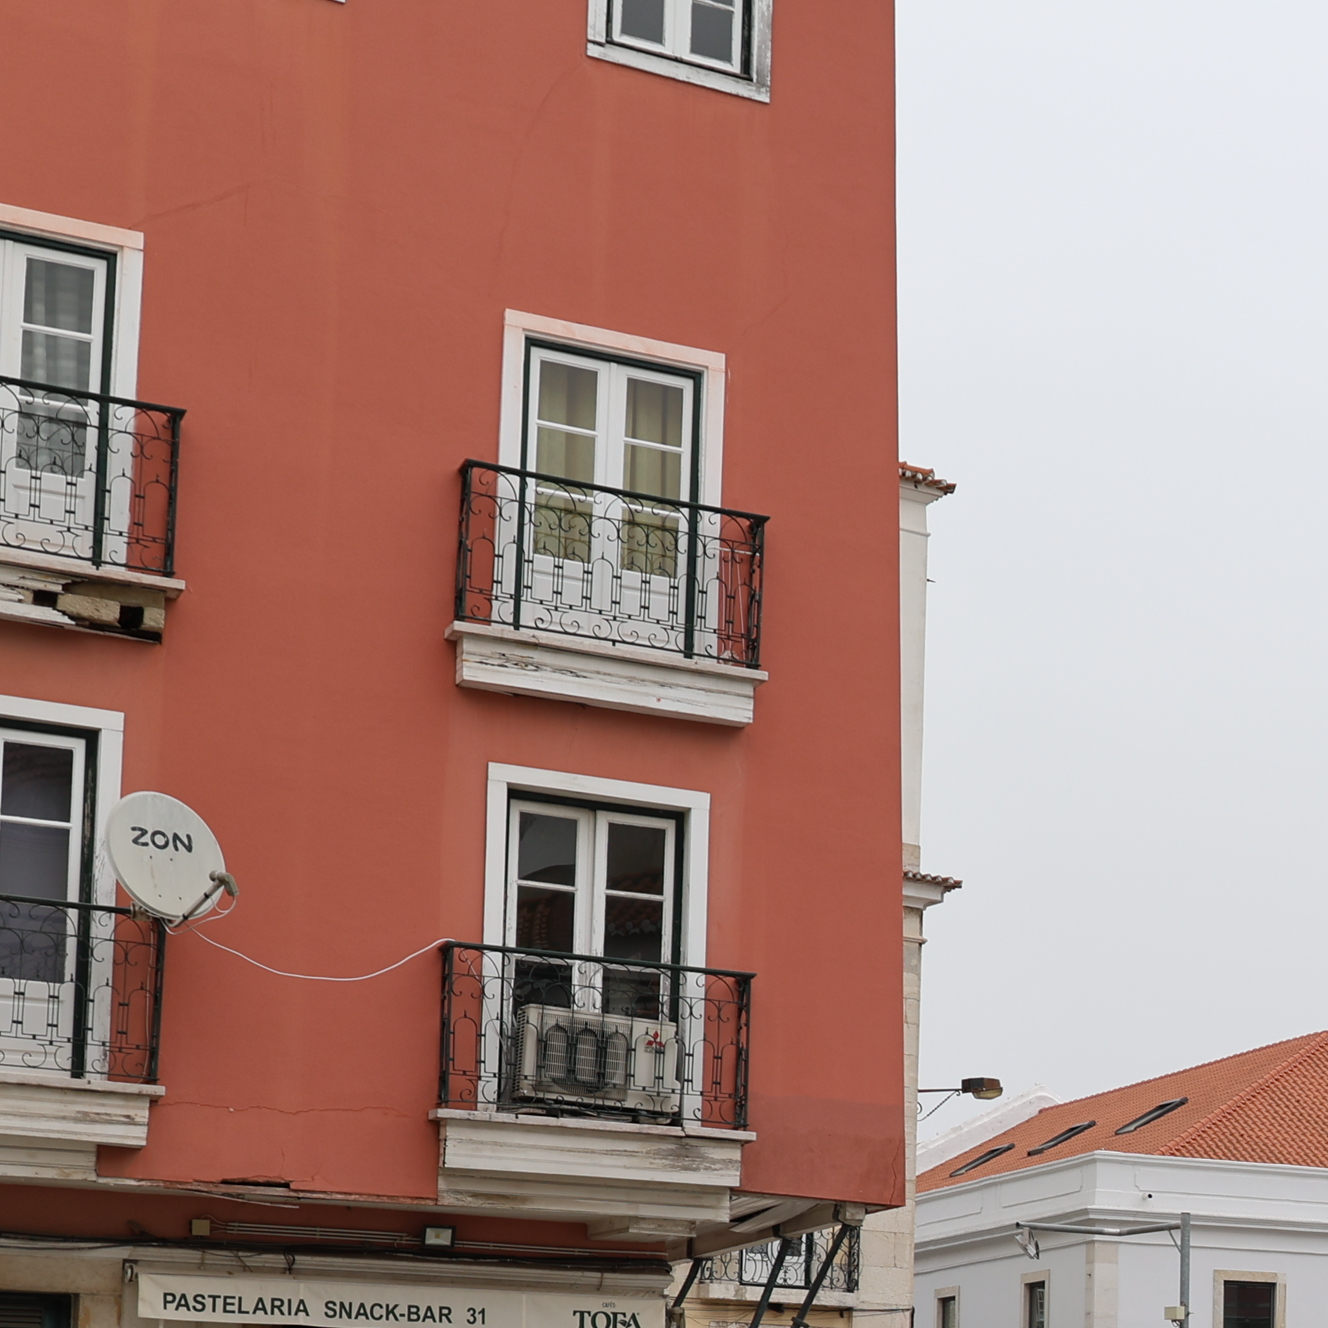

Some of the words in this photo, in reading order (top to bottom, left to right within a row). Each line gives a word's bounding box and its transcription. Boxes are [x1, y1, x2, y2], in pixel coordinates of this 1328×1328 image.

[131, 826, 193, 853] ZON
[162, 1292, 310, 1317] PASTELARIA
[324, 1300, 453, 1324] SNACK-BAR
[466, 1307, 487, 1325] 31
